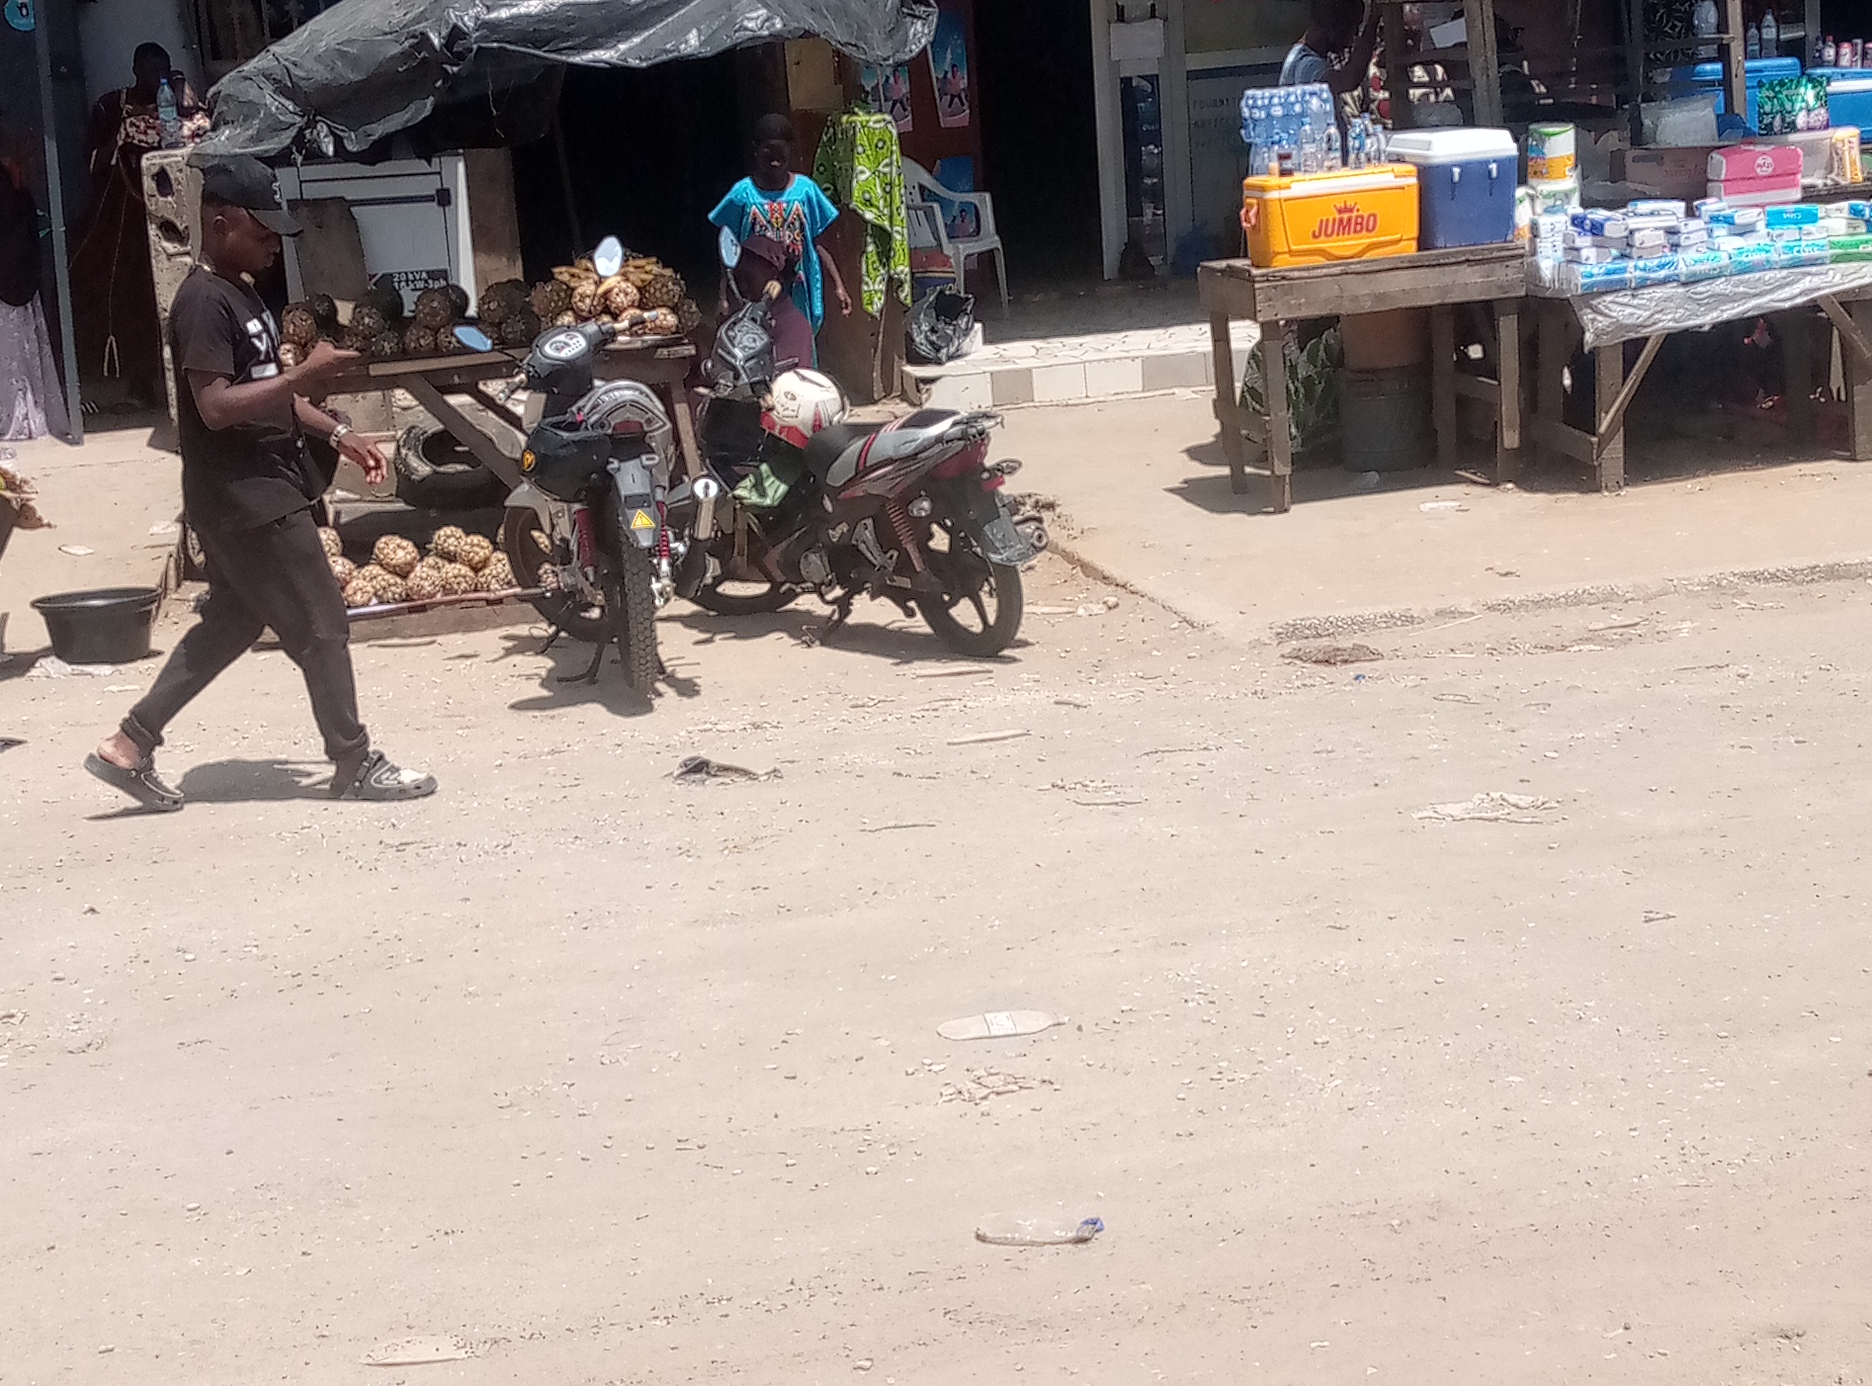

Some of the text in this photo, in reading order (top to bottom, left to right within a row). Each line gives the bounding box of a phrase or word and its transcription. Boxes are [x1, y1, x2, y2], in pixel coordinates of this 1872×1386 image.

[1311, 213, 1378, 240] JUMBO
[392, 271, 428, 282] 20 kVA
